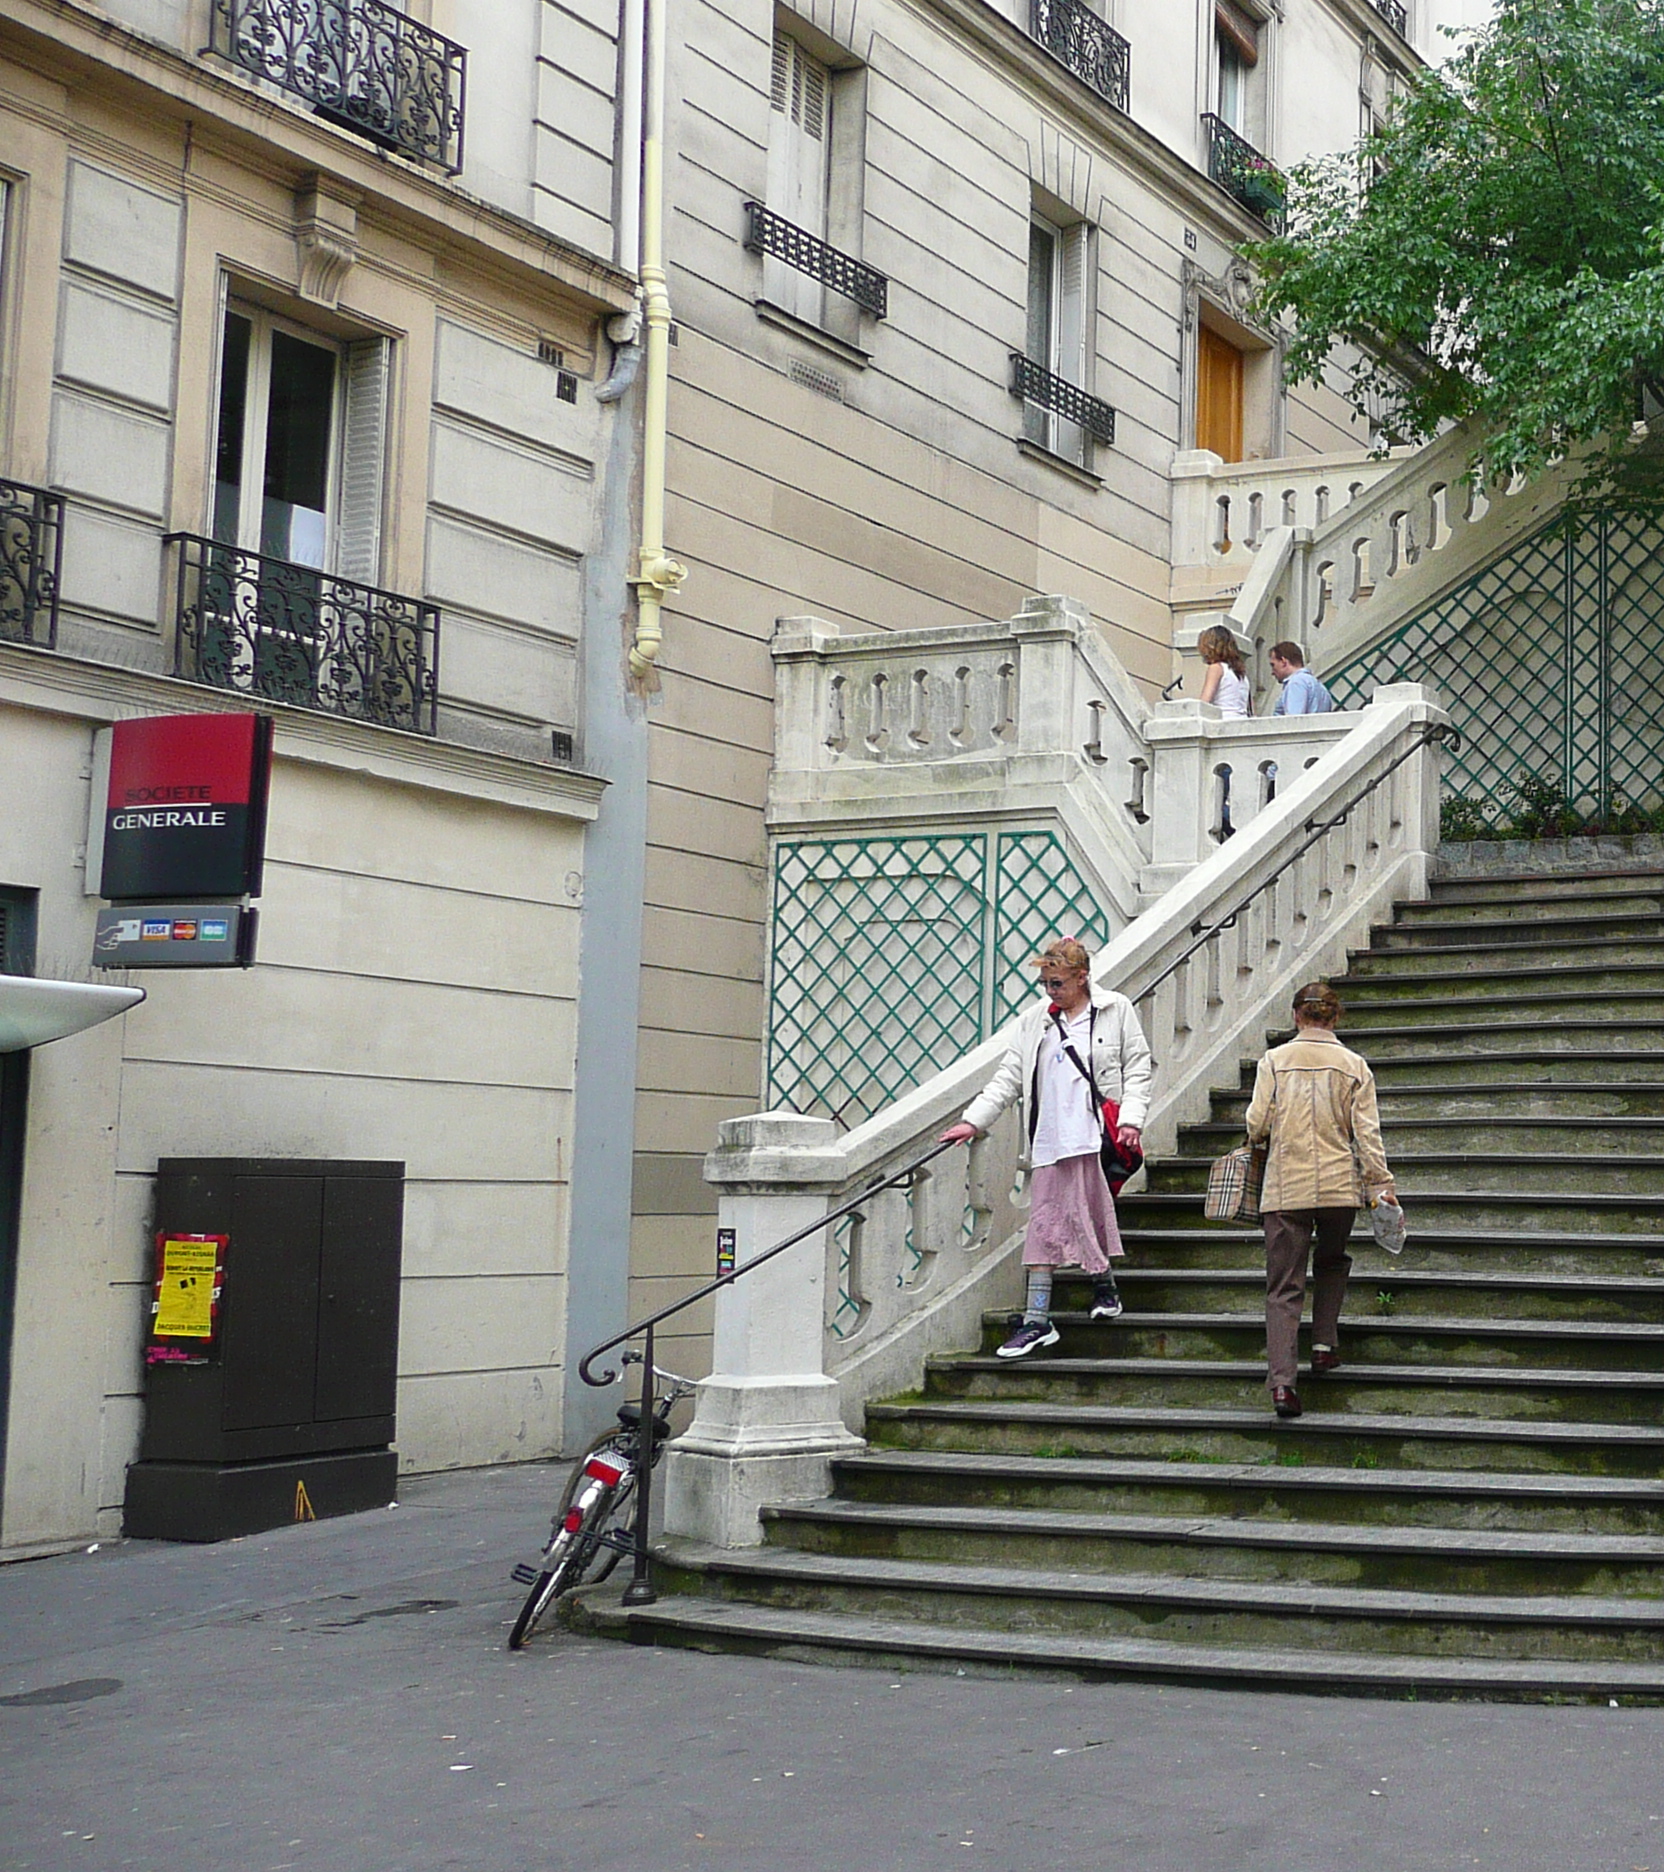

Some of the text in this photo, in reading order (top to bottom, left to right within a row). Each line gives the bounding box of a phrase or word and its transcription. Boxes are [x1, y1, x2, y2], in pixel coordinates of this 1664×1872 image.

[126, 786, 211, 801] SOCIETE
[113, 811, 226, 830] GENERALE
[146, 925, 166, 935] VISA
